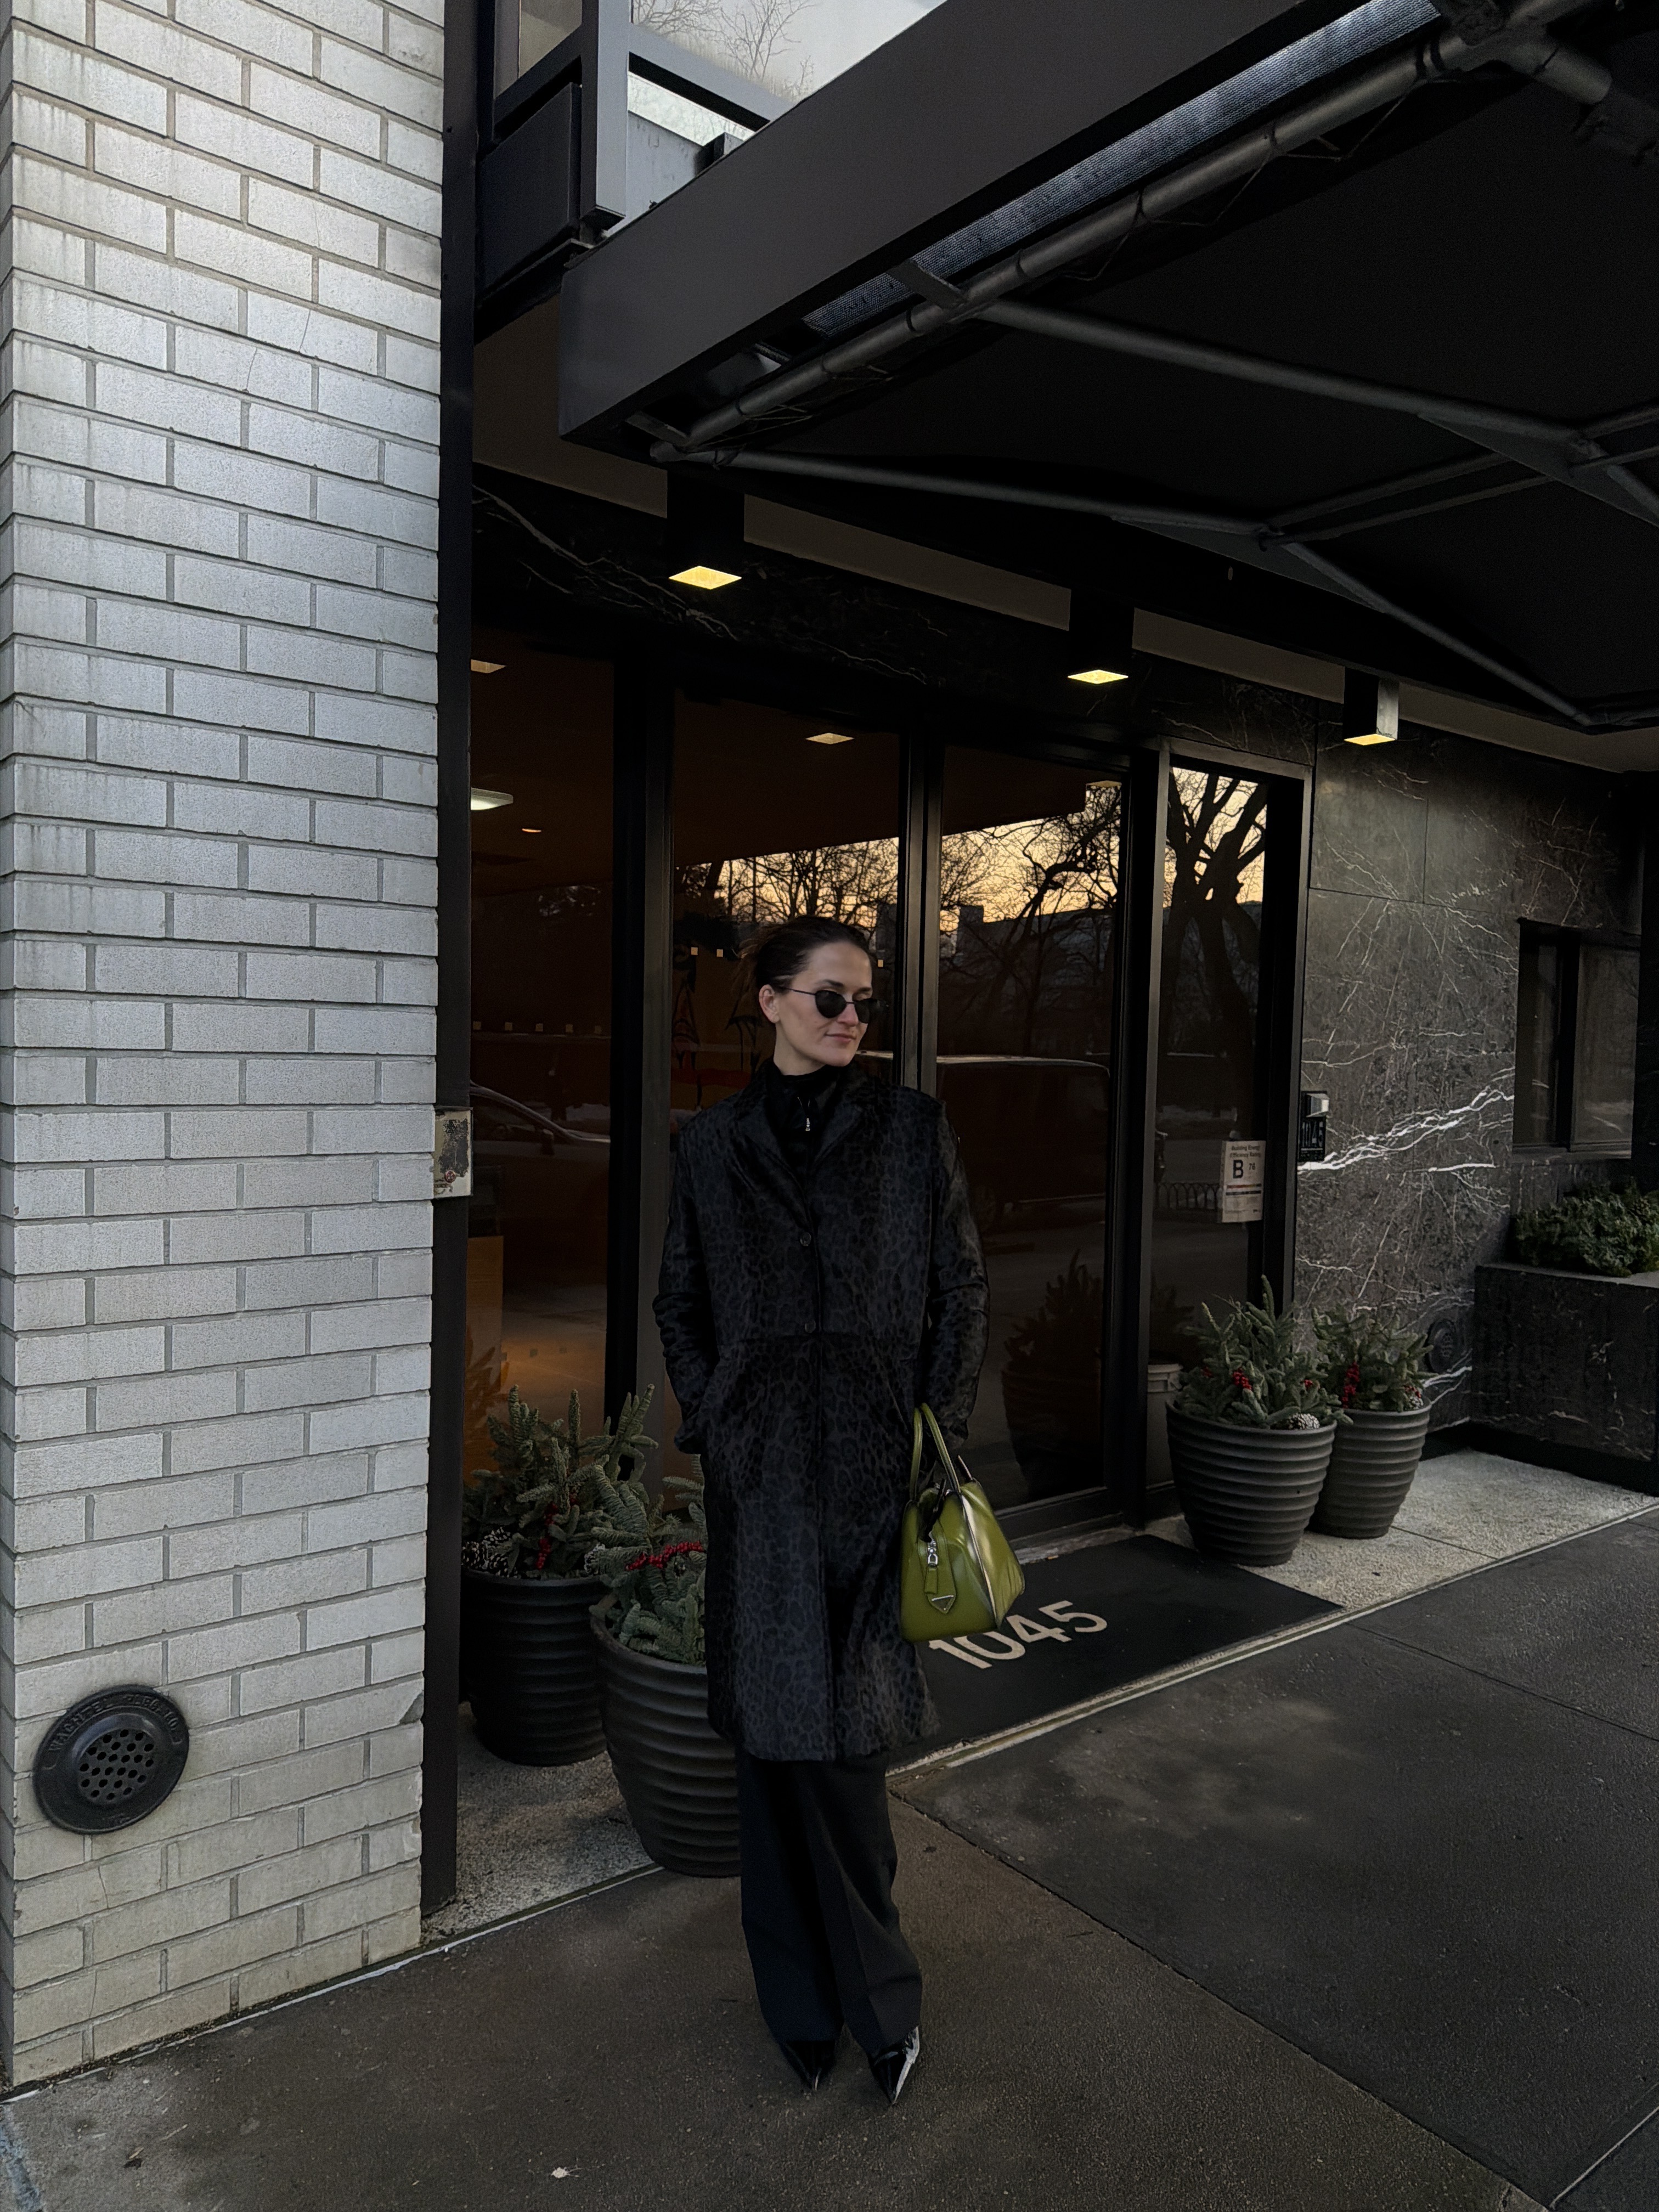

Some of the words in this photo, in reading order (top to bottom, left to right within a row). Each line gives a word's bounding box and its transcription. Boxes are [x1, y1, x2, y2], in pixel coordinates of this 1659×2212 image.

[1302, 1121, 1323, 1147] 1045
[1233, 1159, 1244, 1179] B
[928, 1600, 1108, 1669] 1045
